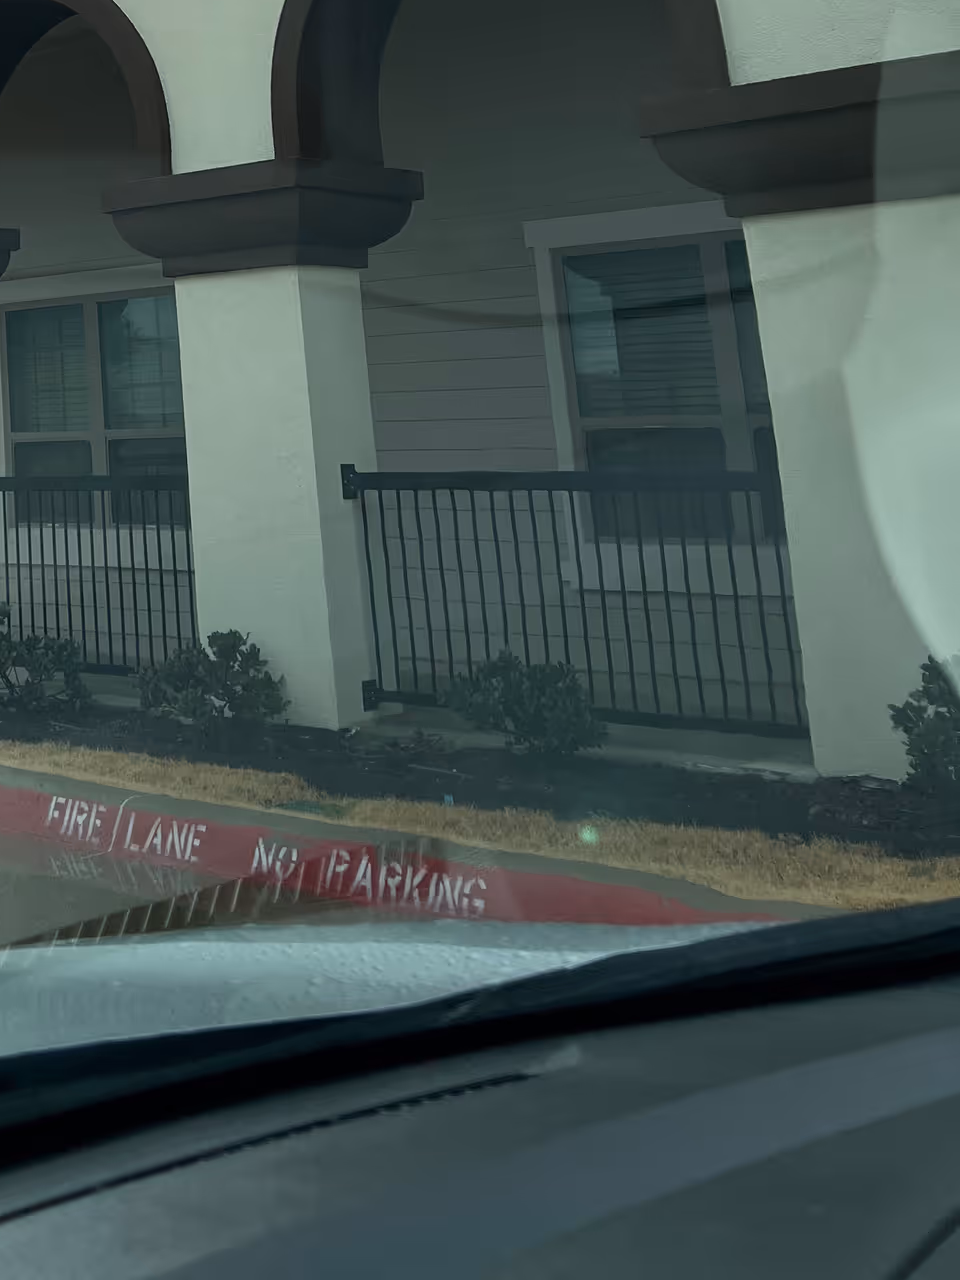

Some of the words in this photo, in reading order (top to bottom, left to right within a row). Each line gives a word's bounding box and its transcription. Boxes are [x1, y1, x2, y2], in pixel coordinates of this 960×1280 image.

[46, 795, 107, 845] FIRE
[124, 811, 207, 862] LANE
[250, 837, 298, 880] NO
[324, 846, 488, 912] PARKING
